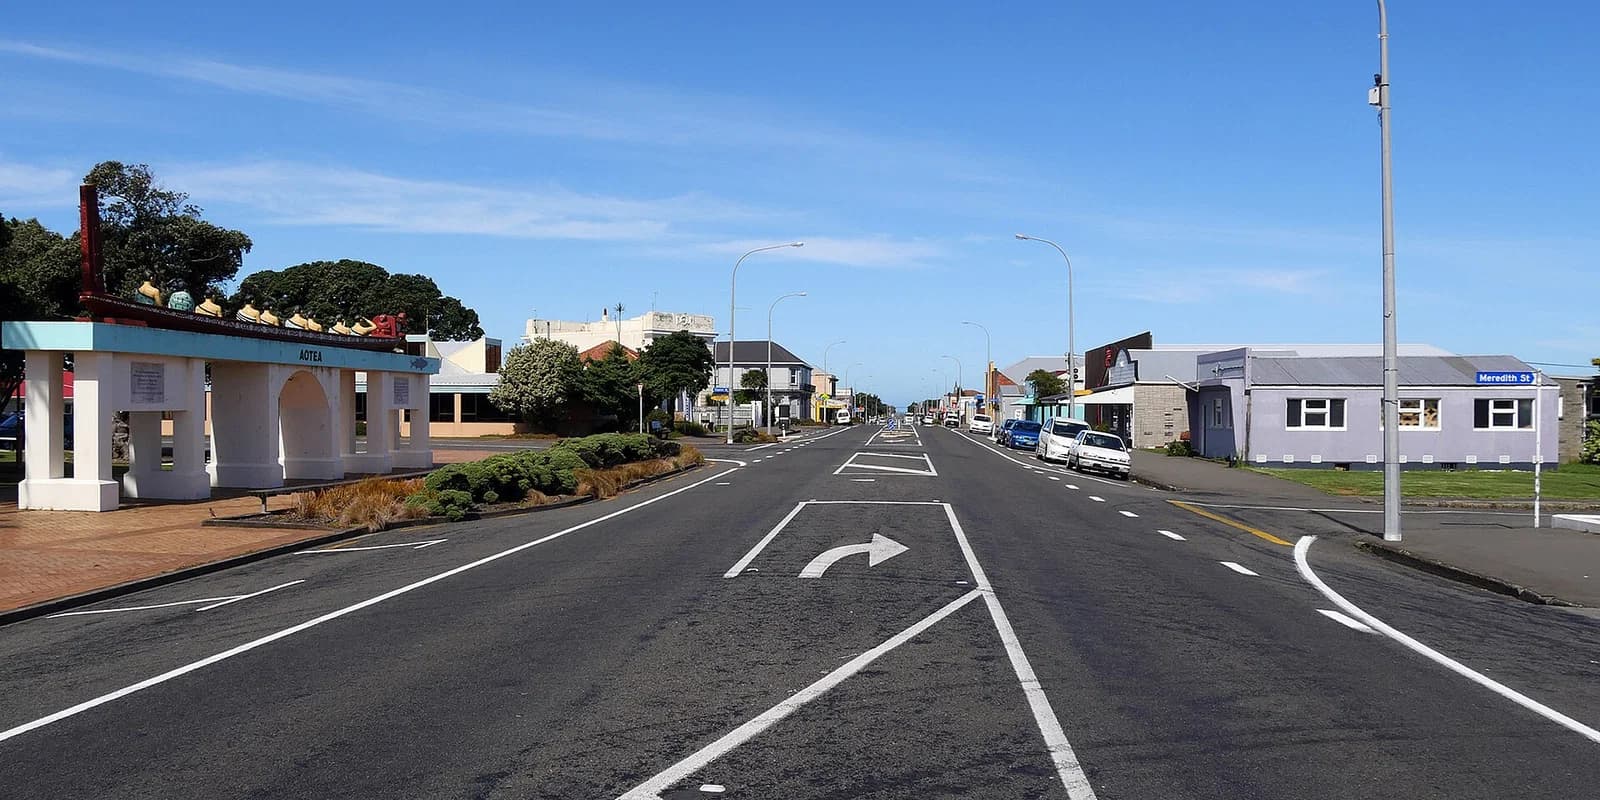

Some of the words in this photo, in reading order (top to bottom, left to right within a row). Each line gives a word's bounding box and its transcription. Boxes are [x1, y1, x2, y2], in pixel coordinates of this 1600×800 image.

[299, 349, 322, 362] AOTEA
[1479, 374, 1518, 382] Meredith
[1520, 374, 1530, 382] St
